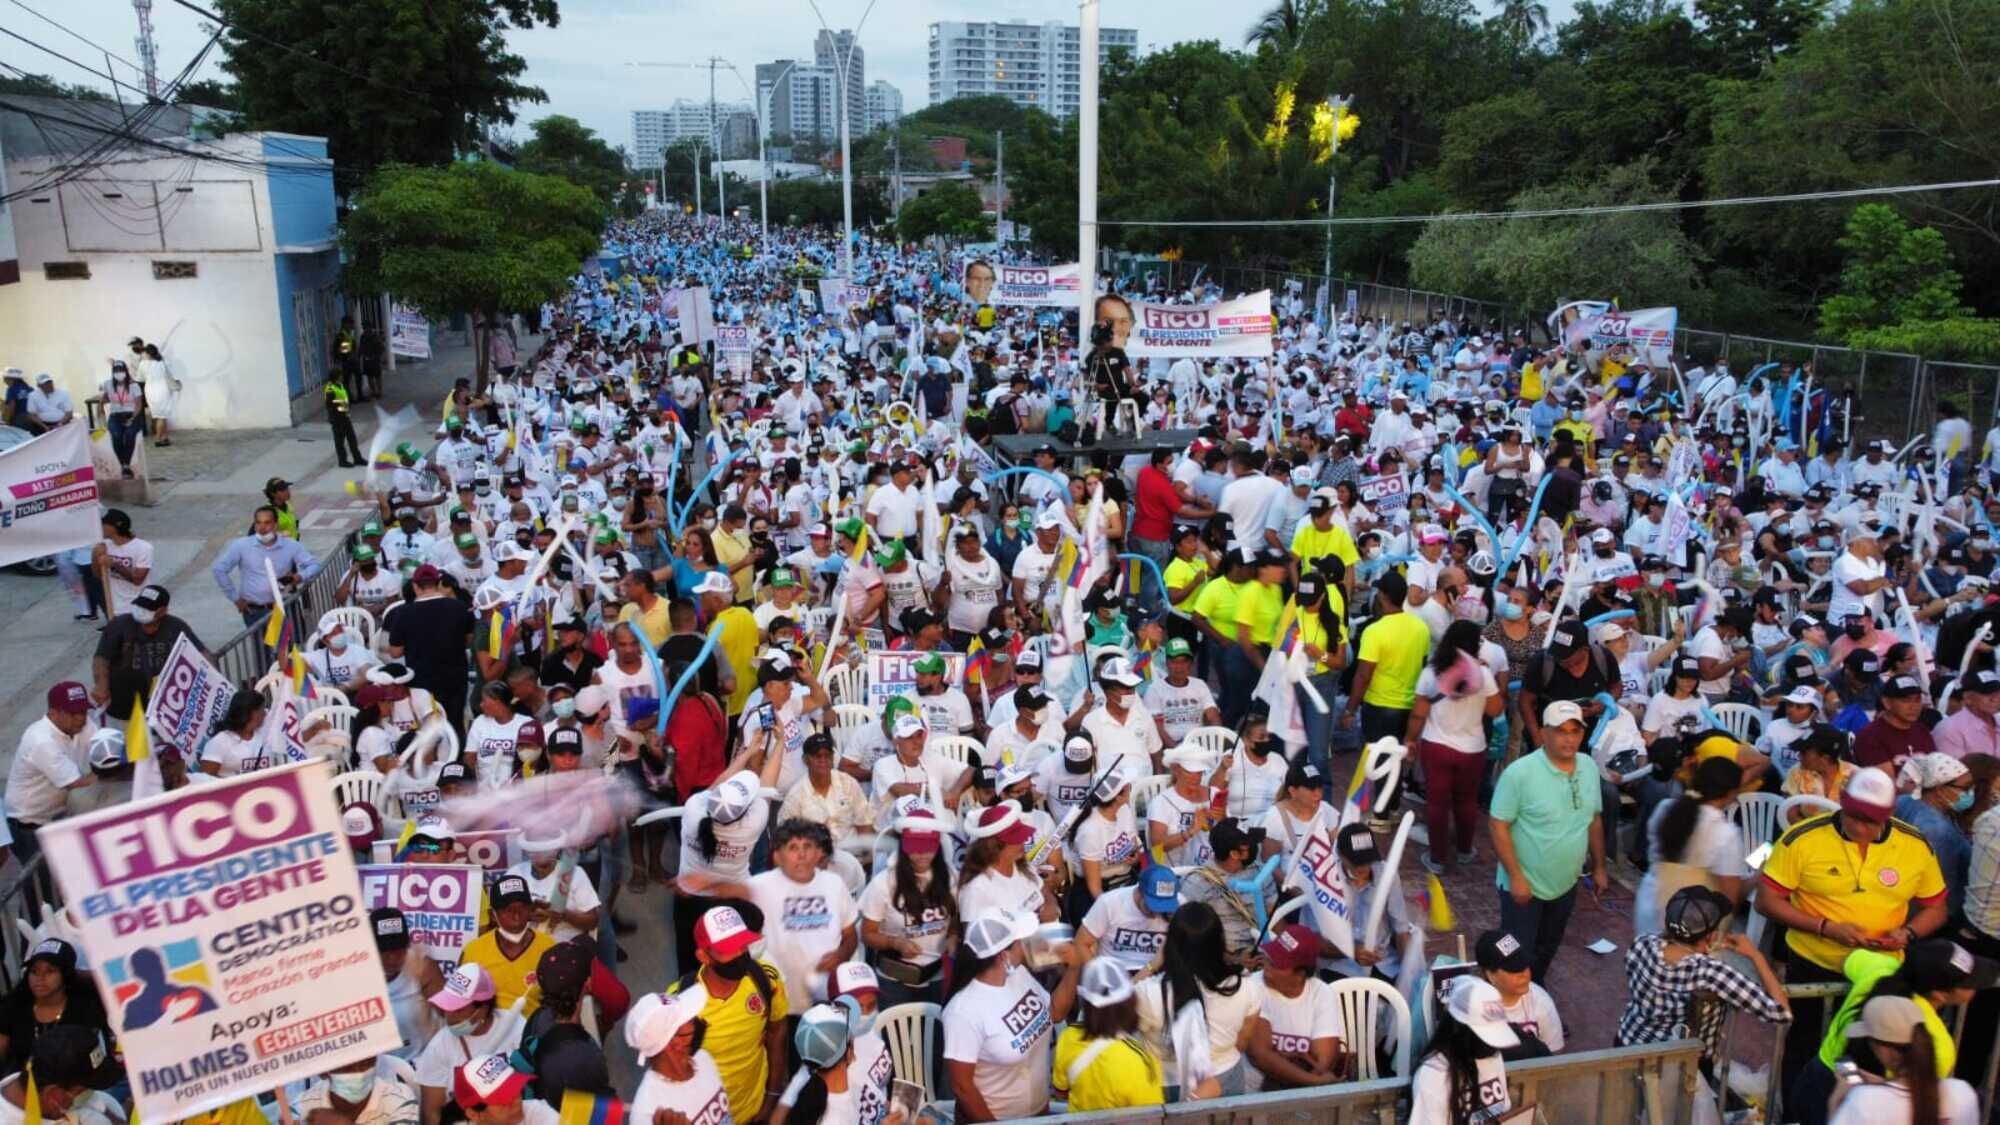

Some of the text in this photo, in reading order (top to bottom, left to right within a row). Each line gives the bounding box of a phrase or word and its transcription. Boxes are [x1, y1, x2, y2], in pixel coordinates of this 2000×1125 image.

[1005, 270, 1047, 284] FICO
[719, 328, 746, 338] FICO
[1140, 329, 1150, 337] EL
[1152, 329, 1217, 338] PRESIDENTE
[1148, 309, 1206, 327] FICO
[1144, 338, 1212, 347] DE LA GENTE
[483, 739, 512, 750] FICO
[405, 791, 438, 803] FICO
[90, 785, 298, 881] FICO
[82, 831, 338, 921] EL PRESIDENTE
[364, 873, 461, 911] FICO
[113, 859, 327, 938] DE LA GENTE
[210, 894, 354, 955] CENTRO
[405, 913, 475, 931] SIDENTE
[1118, 930, 1168, 947] FICO
[223, 947, 327, 990] Mano firme
[227, 949, 371, 1006] Corazón grande
[210, 1000, 299, 1042] Apoya:
[1007, 995, 1042, 1034] FICO
[139, 1043, 250, 1095] HOLMES
[174, 1031, 368, 1101] POR UN NUEVO MAGDALENA
